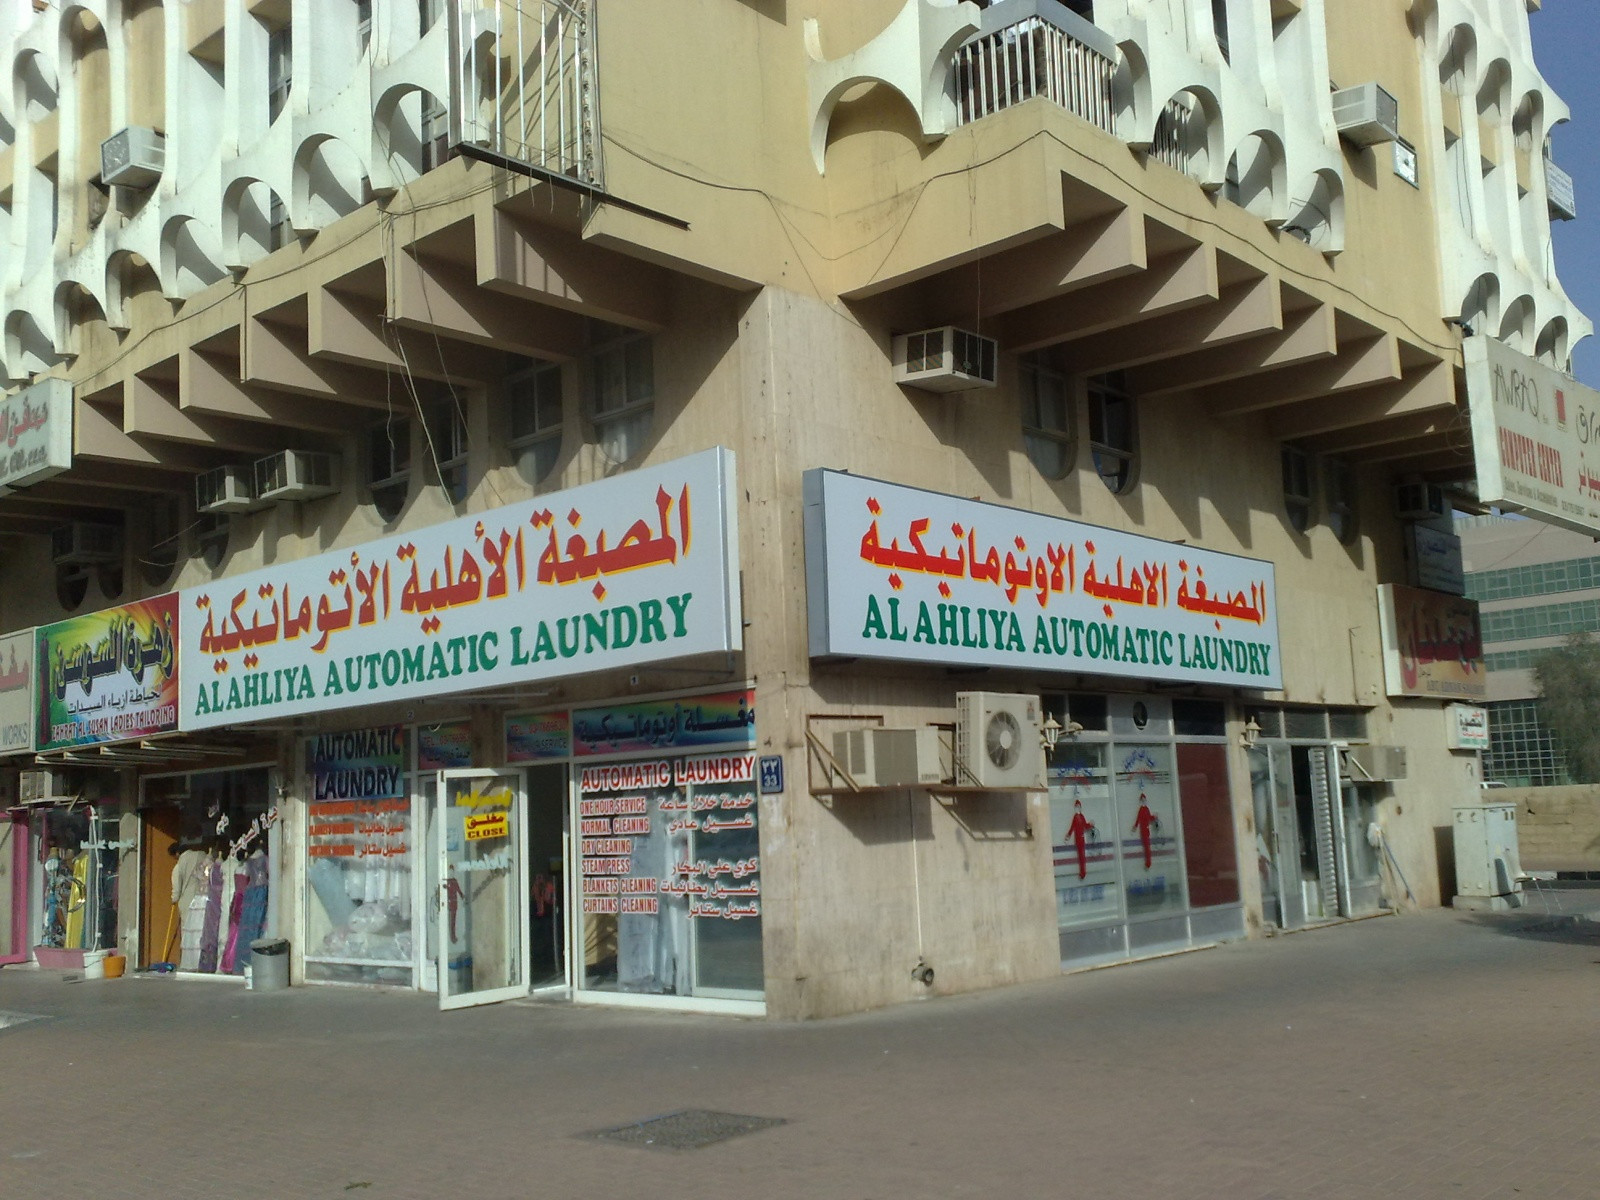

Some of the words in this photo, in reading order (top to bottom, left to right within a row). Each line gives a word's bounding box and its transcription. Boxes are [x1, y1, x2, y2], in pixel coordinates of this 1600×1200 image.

[530, 482, 692, 603] المصبغة
[397, 520, 525, 636] الأهلية
[324, 631, 499, 697] AUTOMATIC
[510, 592, 692, 667] LAUNDRY
[1033, 614, 1173, 665] AUTOMATIC
[1178, 633, 1271, 676] LAUNDRY
[110, 713, 134, 731] LADIES
[135, 706, 175, 728] TAILORING
[316, 726, 403, 762] AUTOMATIC
[315, 766, 400, 800] LAUNDRY
[581, 761, 669, 790] AUTOMATIC
[675, 756, 755, 784] LAUNDRY
[764, 774, 777, 787] 33
[580, 801, 593, 815] ONE
[595, 800, 614, 814] HOUR
[615, 797, 646, 813] SERVICE
[467, 827, 505, 839] CLOSE
[581, 820, 611, 834] NORMAL
[613, 818, 650, 833] CLEANING
[582, 840, 595, 854] DRY
[596, 839, 631, 853] CLEANING
[582, 860, 606, 873] STEAM
[606, 859, 630, 873] PRESS
[583, 879, 618, 893] BLANKETS
[620, 878, 657, 892] CLEANING
[583, 899, 618, 912] CURTAINS
[621, 898, 658, 912] CLEANING
